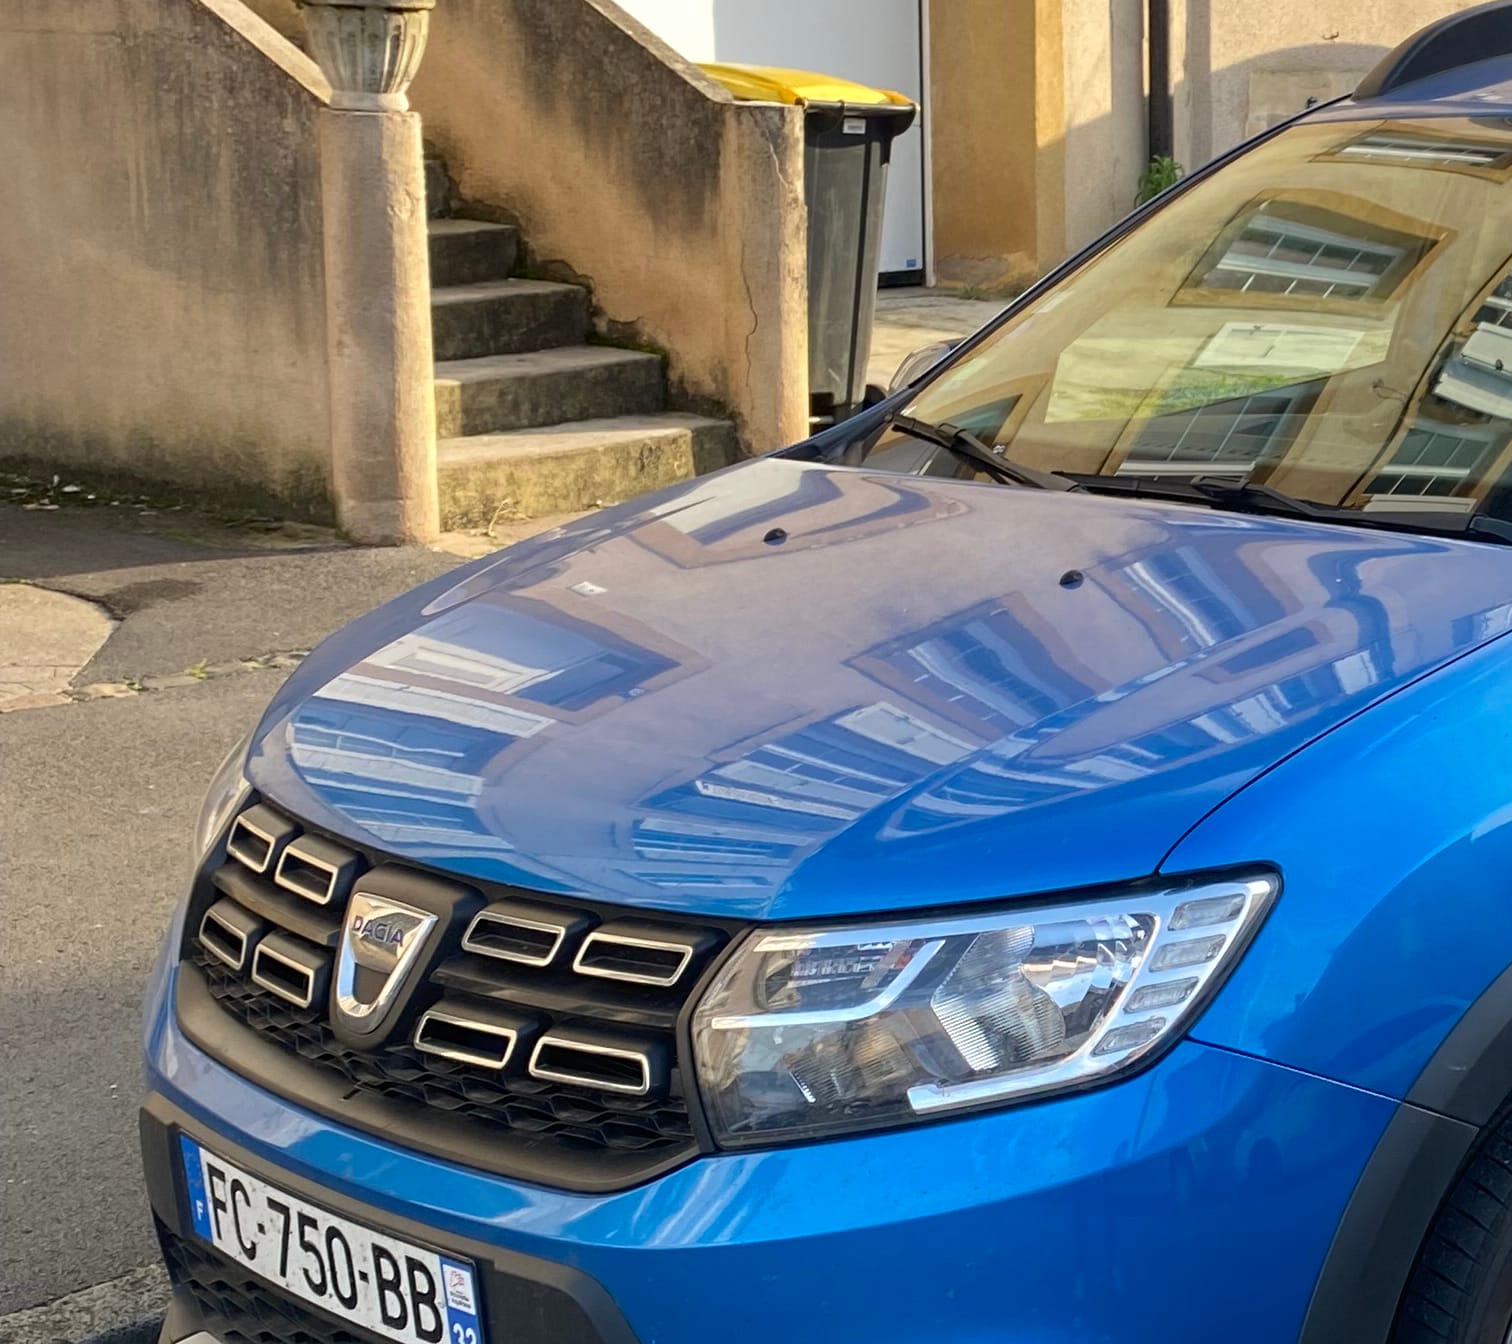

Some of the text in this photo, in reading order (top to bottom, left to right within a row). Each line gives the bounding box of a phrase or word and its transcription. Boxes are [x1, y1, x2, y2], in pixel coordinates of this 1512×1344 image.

[352, 915, 403, 947] DACIA
[195, 1199, 204, 1221] F
[206, 1161, 444, 1344] FC-750-BB
